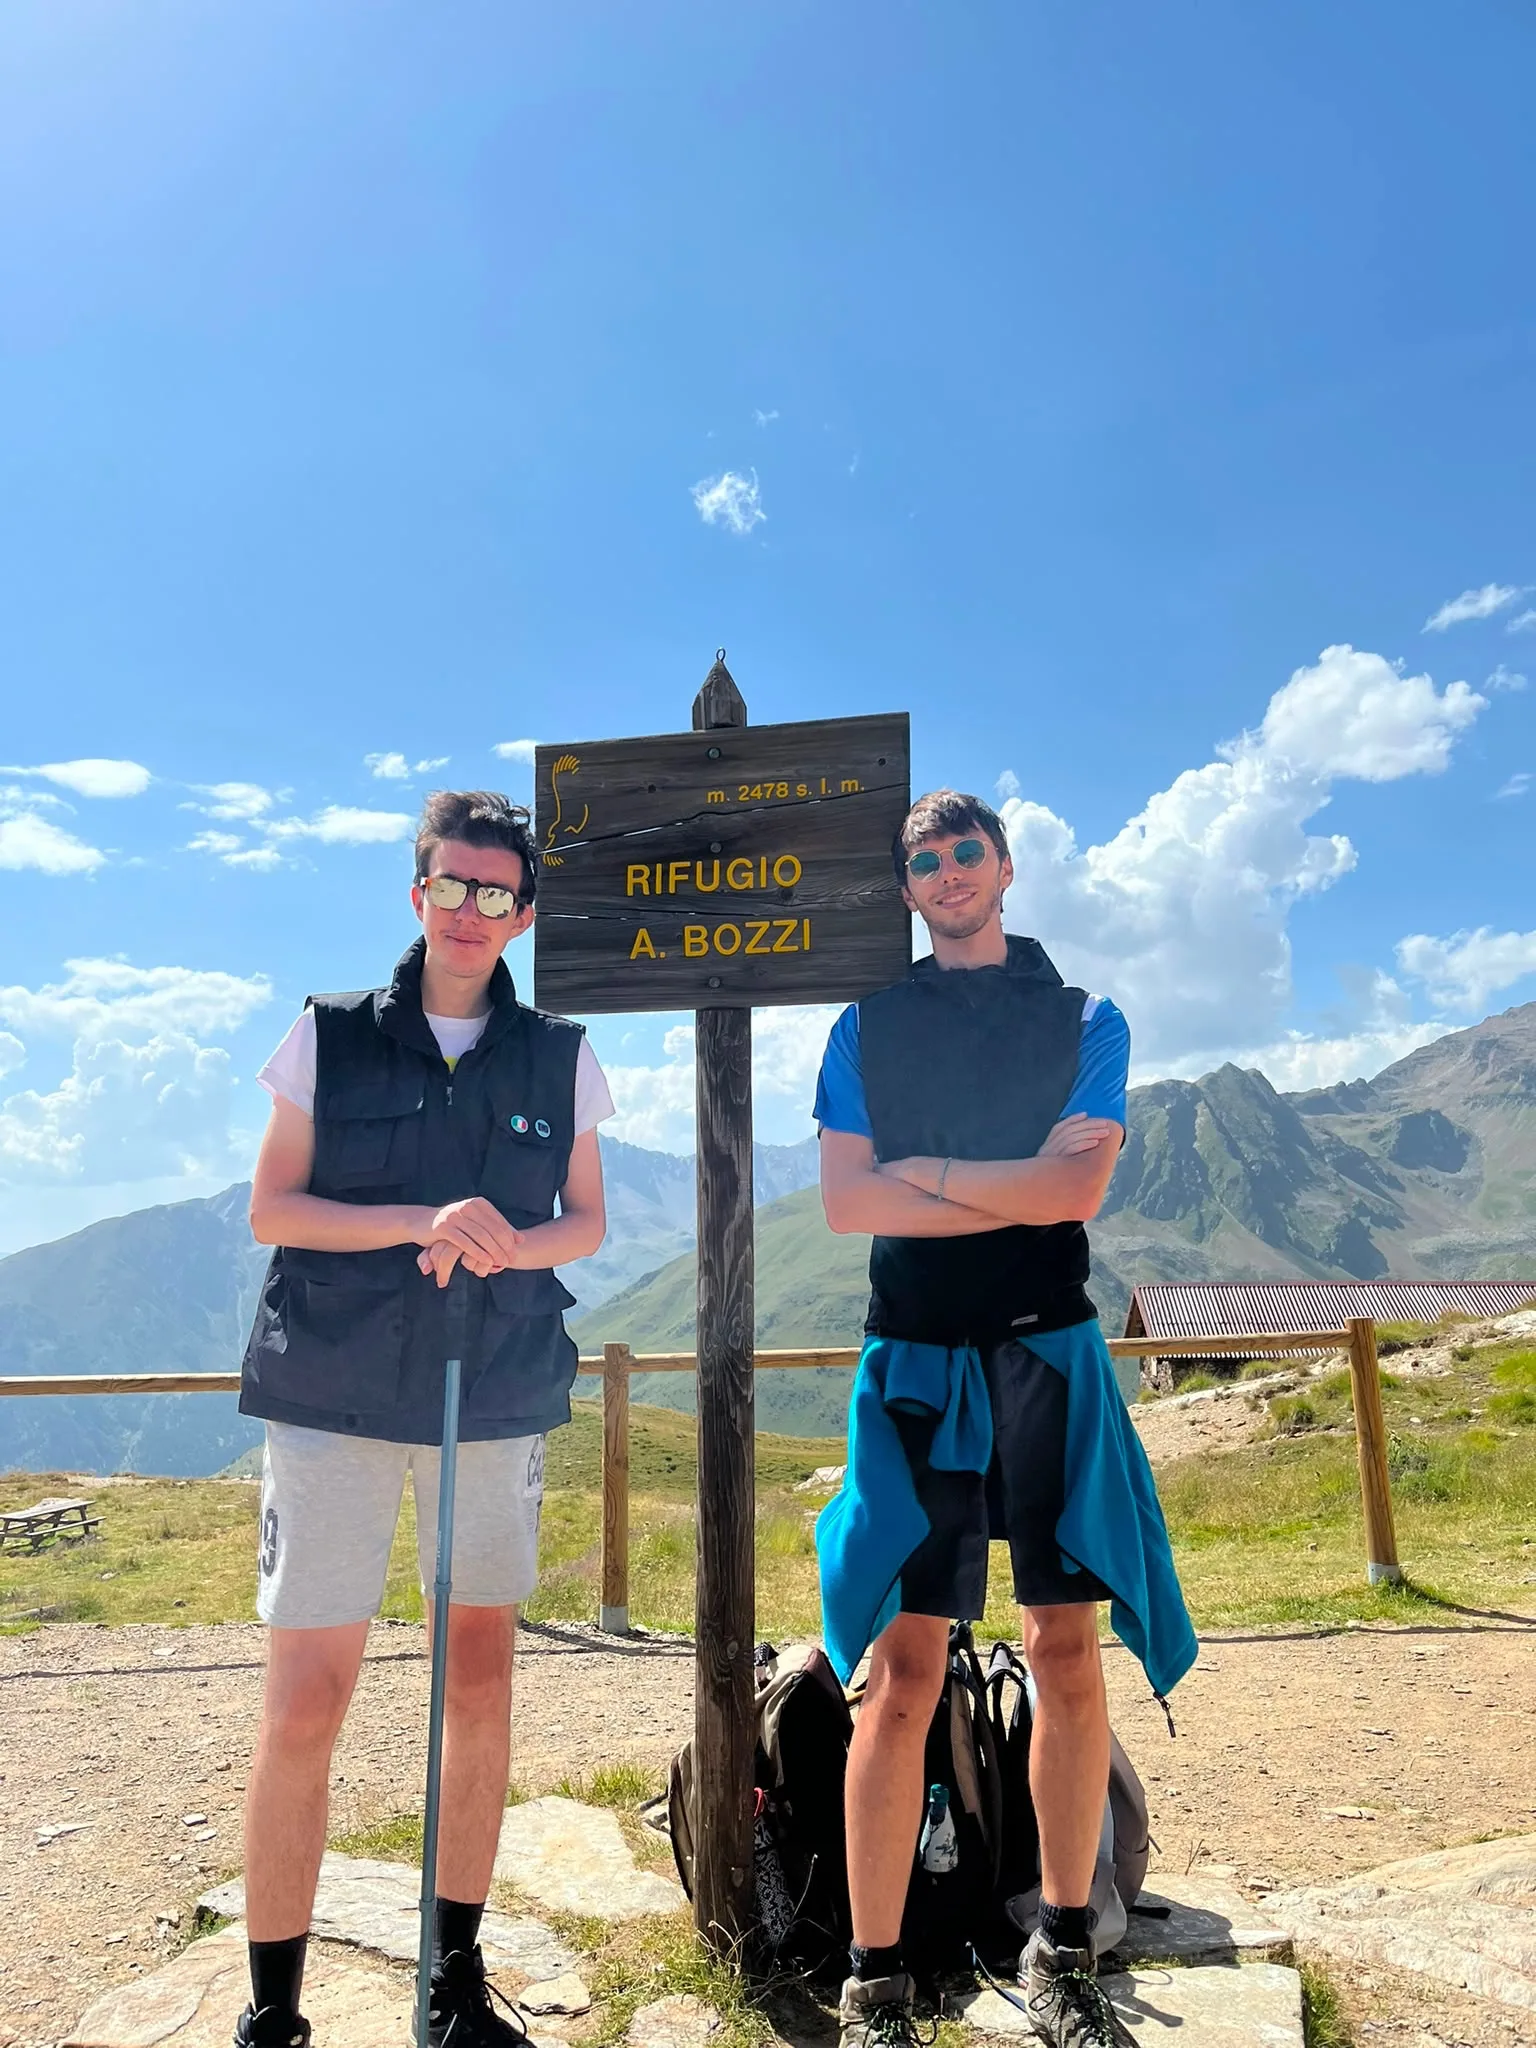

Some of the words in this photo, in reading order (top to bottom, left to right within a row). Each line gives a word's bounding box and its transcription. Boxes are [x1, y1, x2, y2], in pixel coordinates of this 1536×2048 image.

[706, 790, 731, 803] m.
[738, 781, 790, 802] 2478
[796, 783, 813, 797] s.
[840, 779, 866, 793] m.
[626, 854, 802, 896] RIFUGIO
[630, 927, 667, 960] A.
[684, 918, 812, 958] BOZZI
